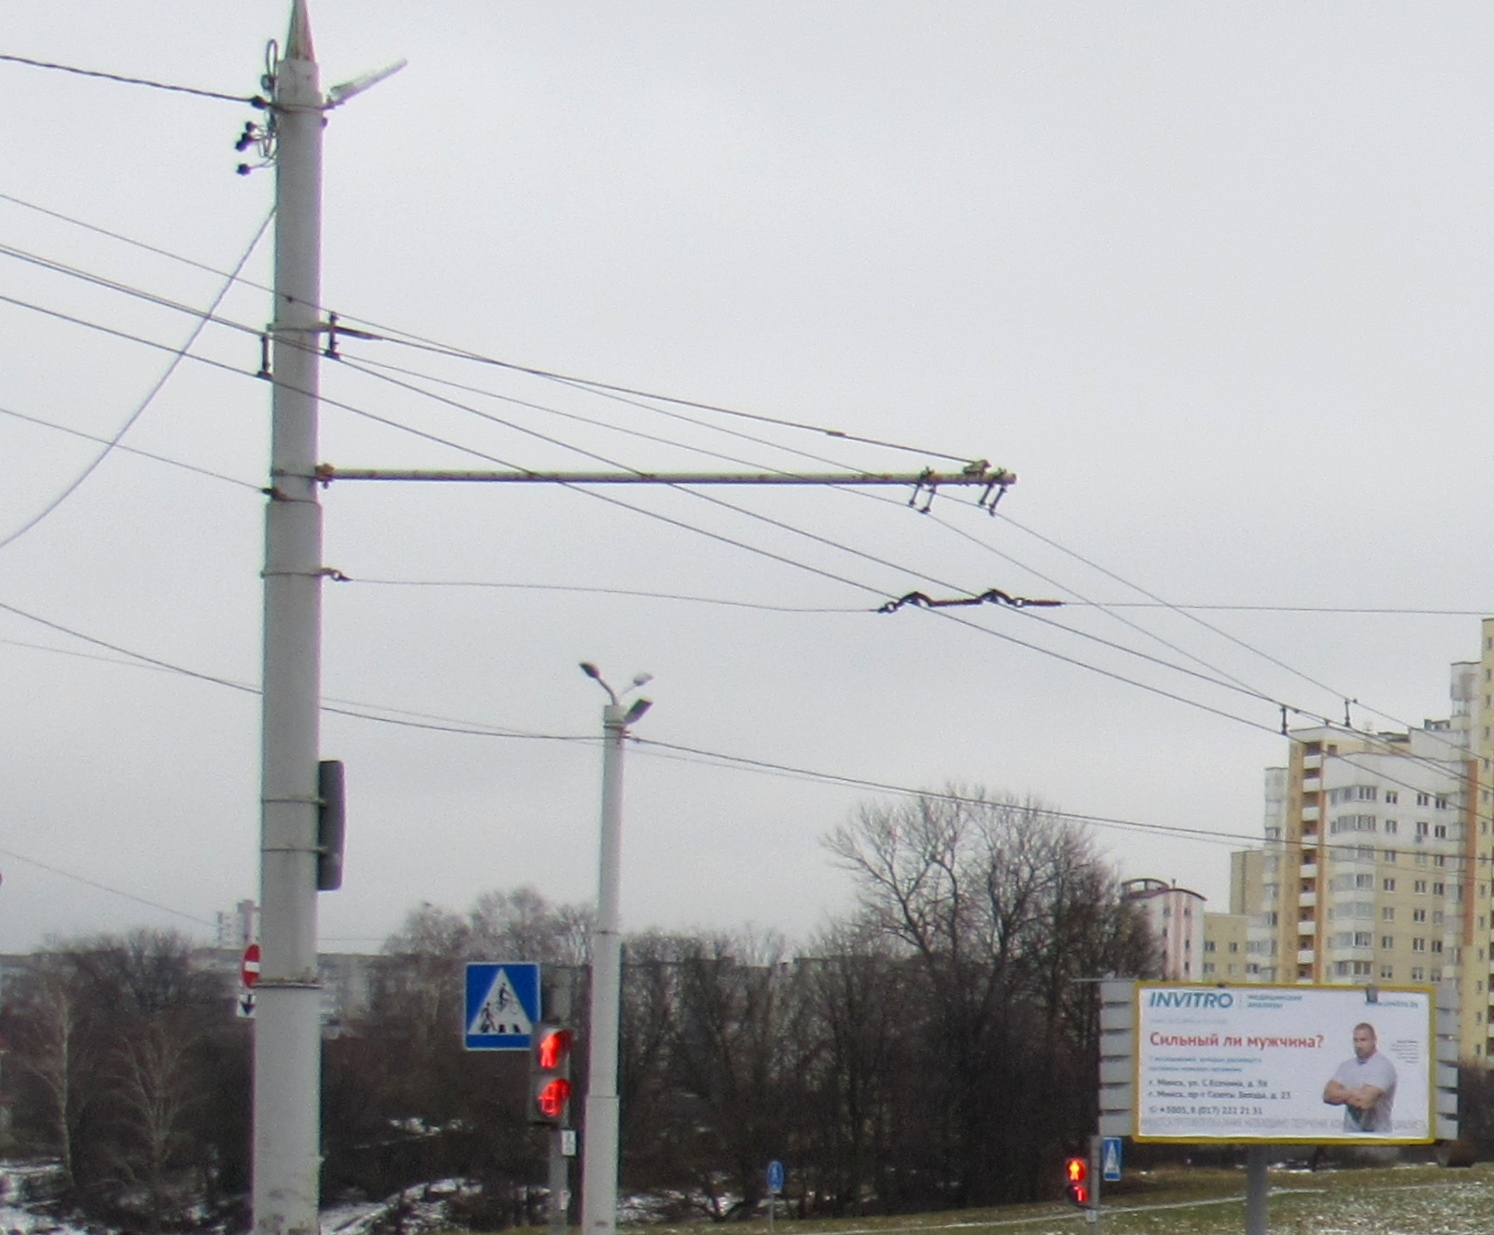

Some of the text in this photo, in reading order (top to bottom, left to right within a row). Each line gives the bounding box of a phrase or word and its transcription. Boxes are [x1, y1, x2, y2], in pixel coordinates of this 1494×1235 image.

[1150, 992, 1234, 1009] INVITRO
[1150, 1031, 1324, 1051] Сильный ли мужчина?
